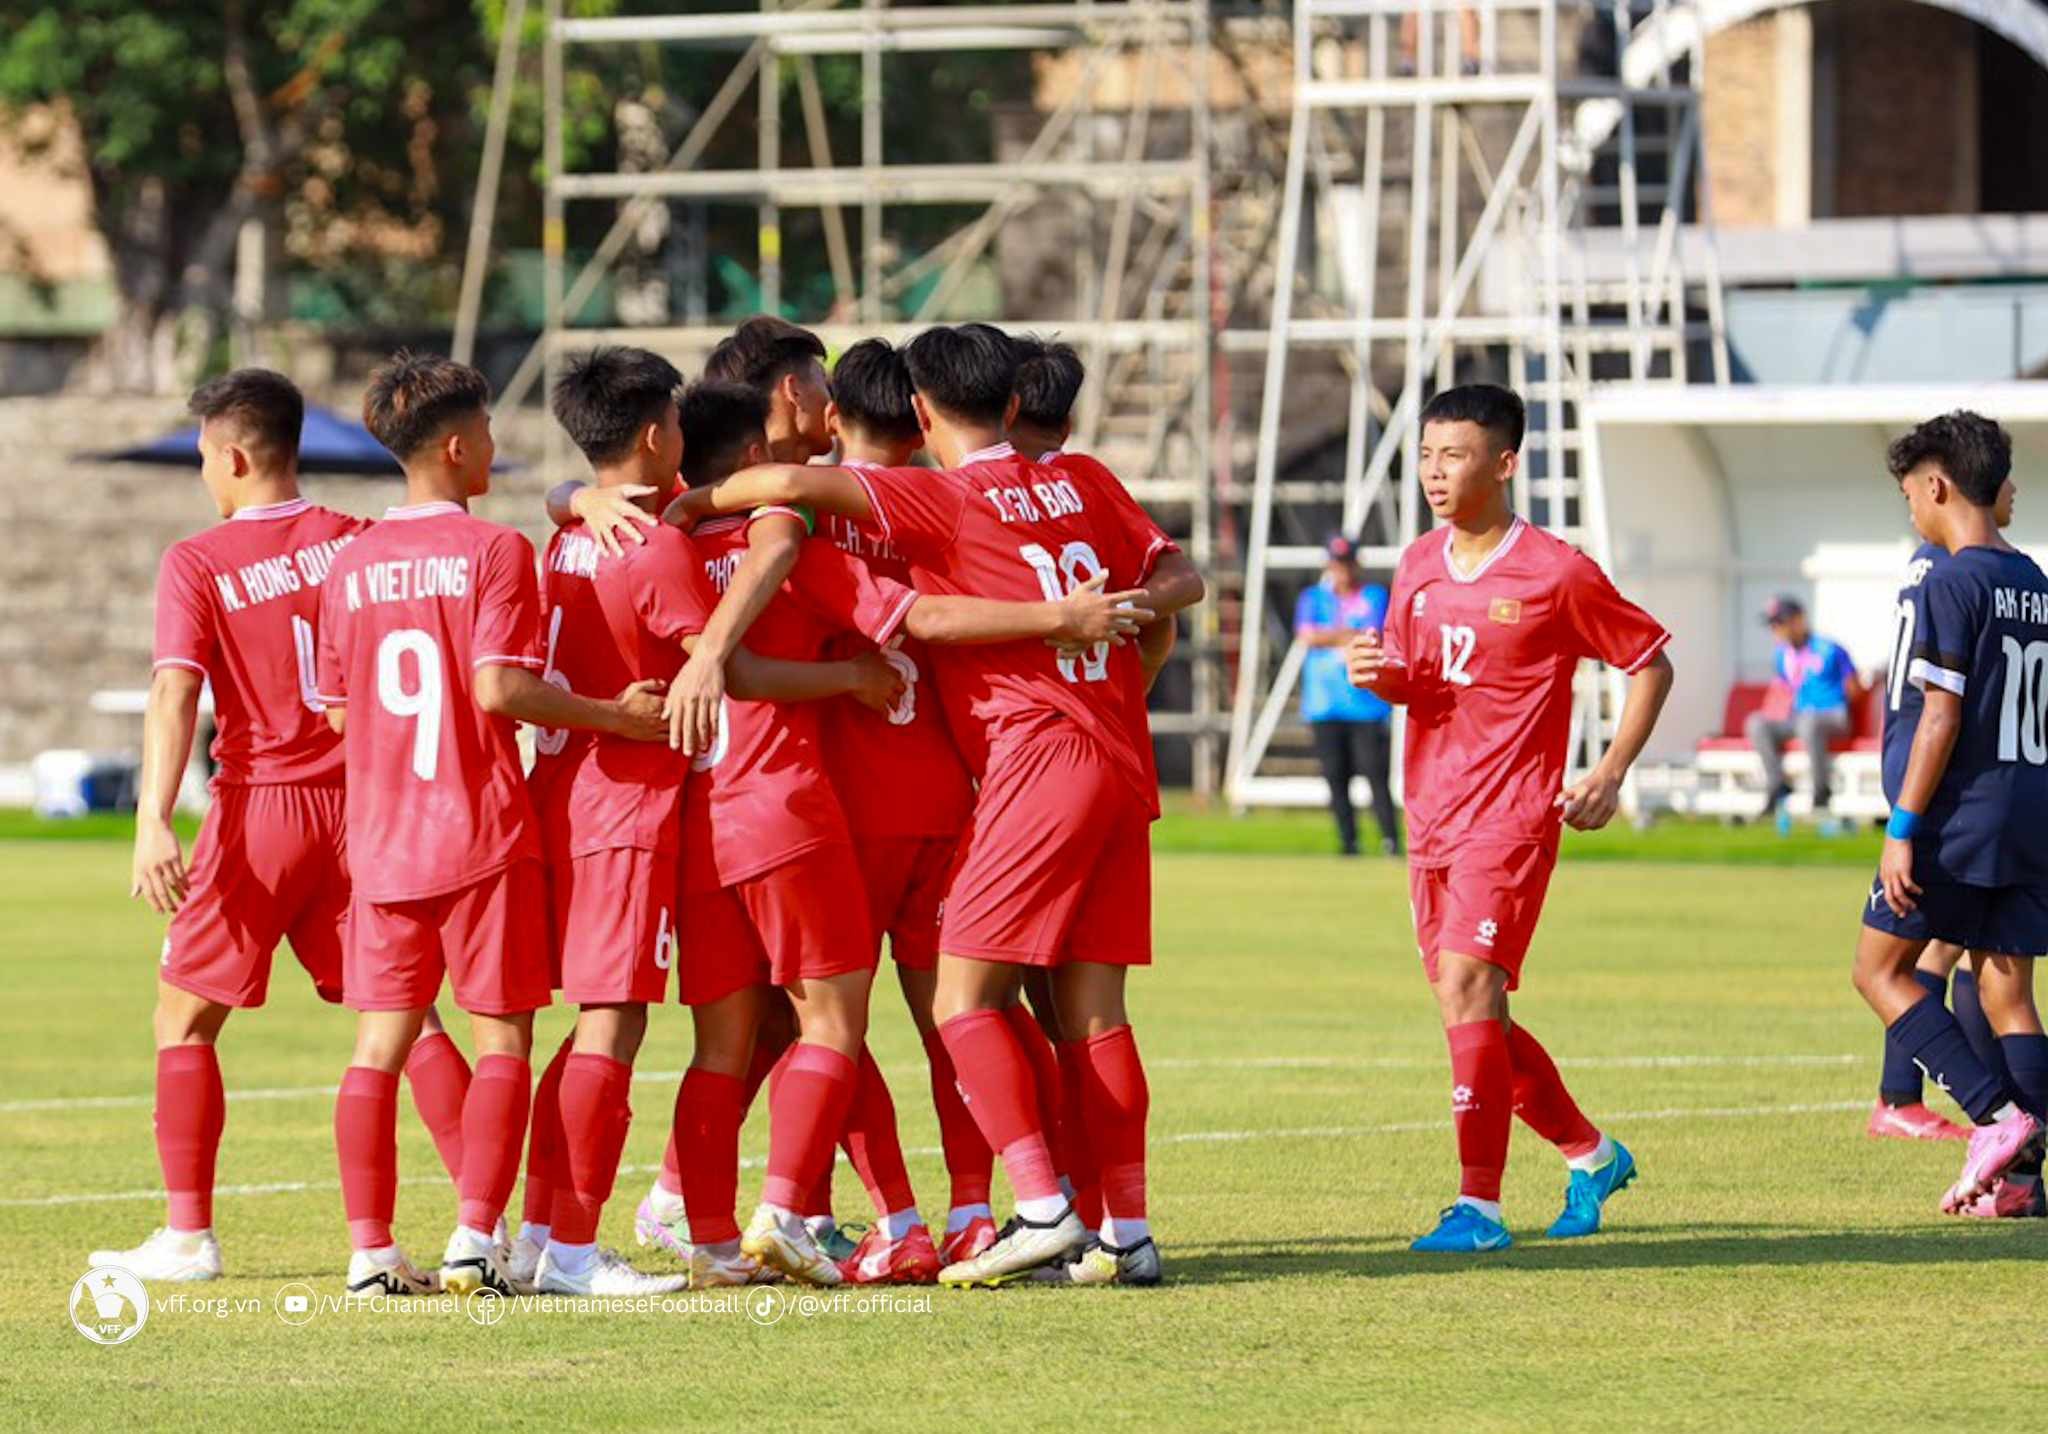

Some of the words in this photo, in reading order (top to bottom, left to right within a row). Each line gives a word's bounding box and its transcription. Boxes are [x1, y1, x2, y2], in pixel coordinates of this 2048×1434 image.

[215, 573, 247, 612] N.
[238, 554, 301, 605] HONG
[295, 534, 355, 587] QUA
[364, 561, 412, 604] VIET
[414, 556, 469, 599] LONG
[1439, 623, 1477, 687] 12
[378, 628, 443, 782] 9
[1997, 634, 2048, 766] 10
[654, 905, 673, 970] 6
